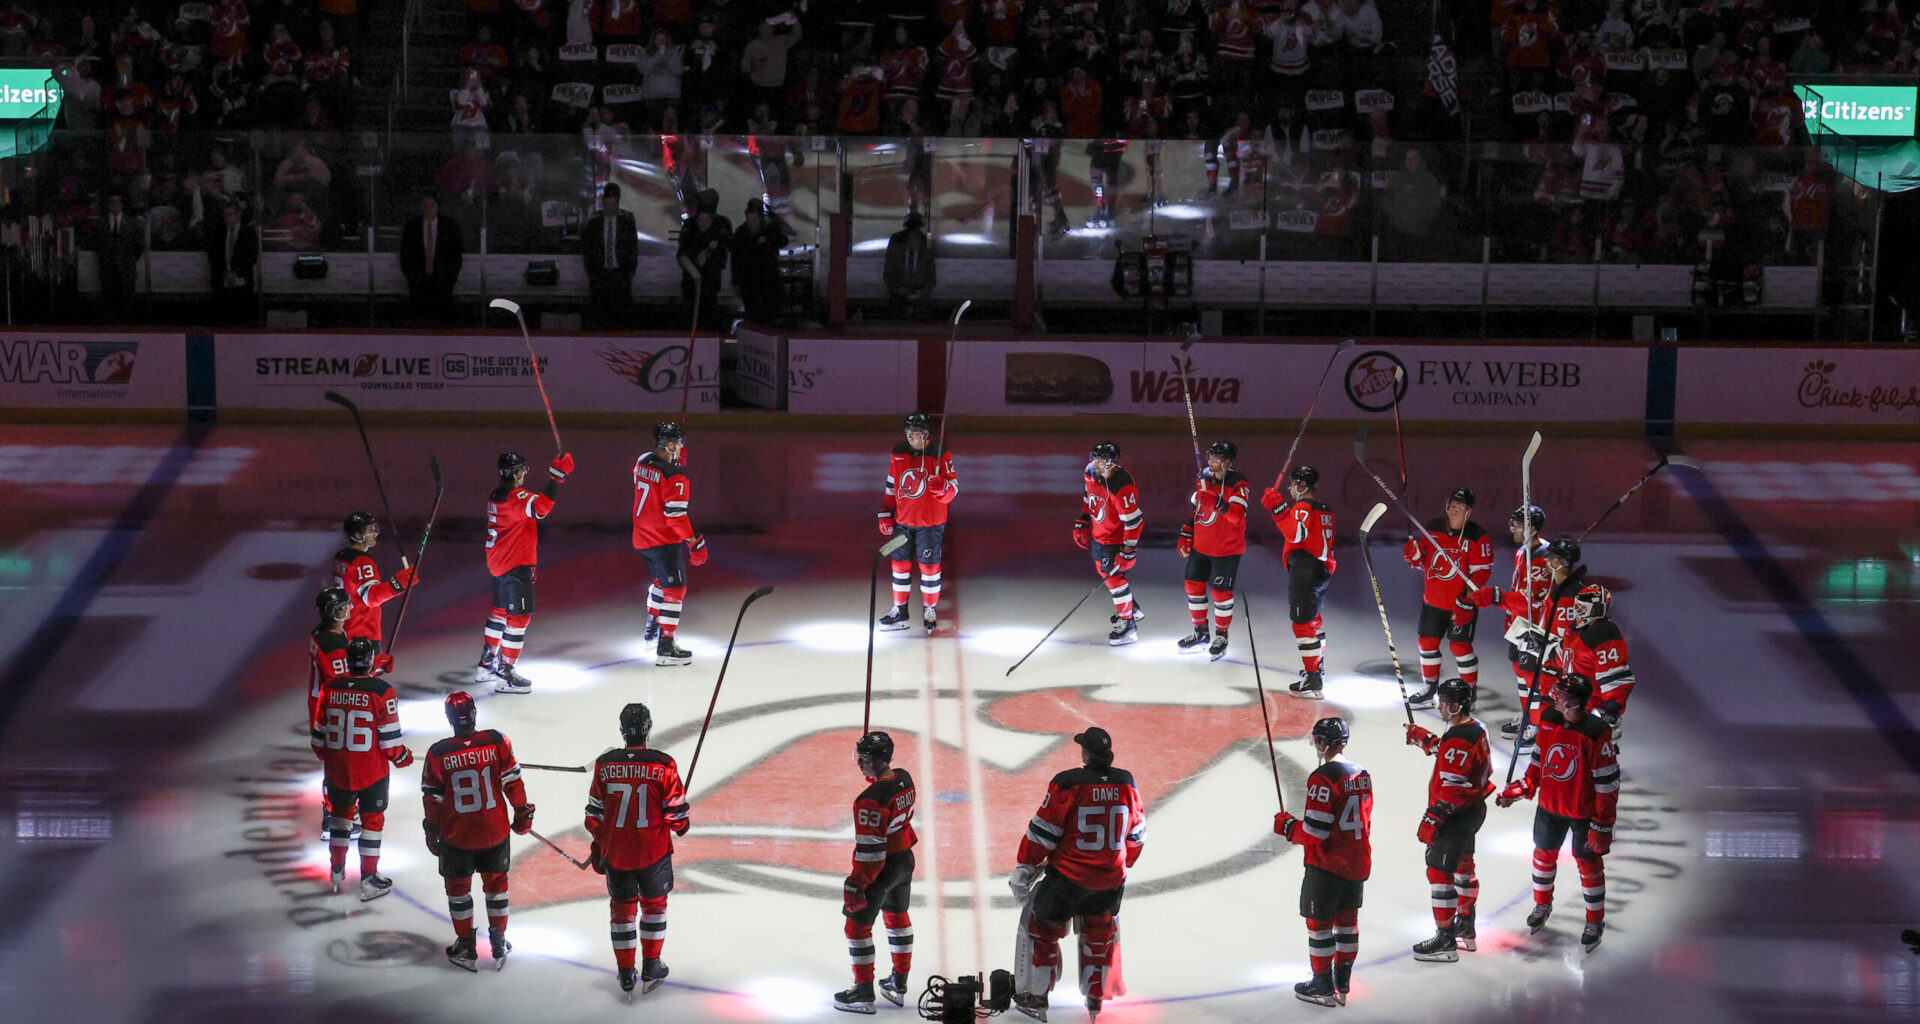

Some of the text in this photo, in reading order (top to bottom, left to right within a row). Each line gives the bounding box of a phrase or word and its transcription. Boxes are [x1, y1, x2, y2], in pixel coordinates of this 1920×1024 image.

[1820, 101, 1904, 120] Citizens
[256, 357, 430, 375] STREAM LIVE
[446, 360, 466, 372] GS
[472, 357, 548, 366] THE GOTHAM
[472, 367, 545, 376] SPORTS APP
[1418, 360, 1581, 388] F.W. WEBB
[58, 388, 128, 399] International
[360, 382, 445, 390] DOWNLOAD TODAY
[1130, 370, 1241, 404] Wawa
[1452, 391, 1541, 407] COMPANY
[675, 482, 684, 496] 7
[636, 480, 651, 518] 7
[1122, 493, 1137, 509] 14
[1294, 509, 1310, 523] 17
[1461, 539, 1470, 553] A
[356, 564, 375, 581] 13
[1597, 647, 1620, 665] 34
[329, 691, 370, 708] HUGHES
[325, 707, 374, 753] 86
[443, 747, 498, 770] GRITSYUK
[1443, 747, 1469, 767] 47
[450, 765, 497, 815] 81
[1092, 787, 1120, 803] DAWS
[1307, 783, 1331, 804] 48
[606, 782, 650, 829] 71
[857, 808, 882, 827] 63
[1075, 804, 1130, 852] 50
